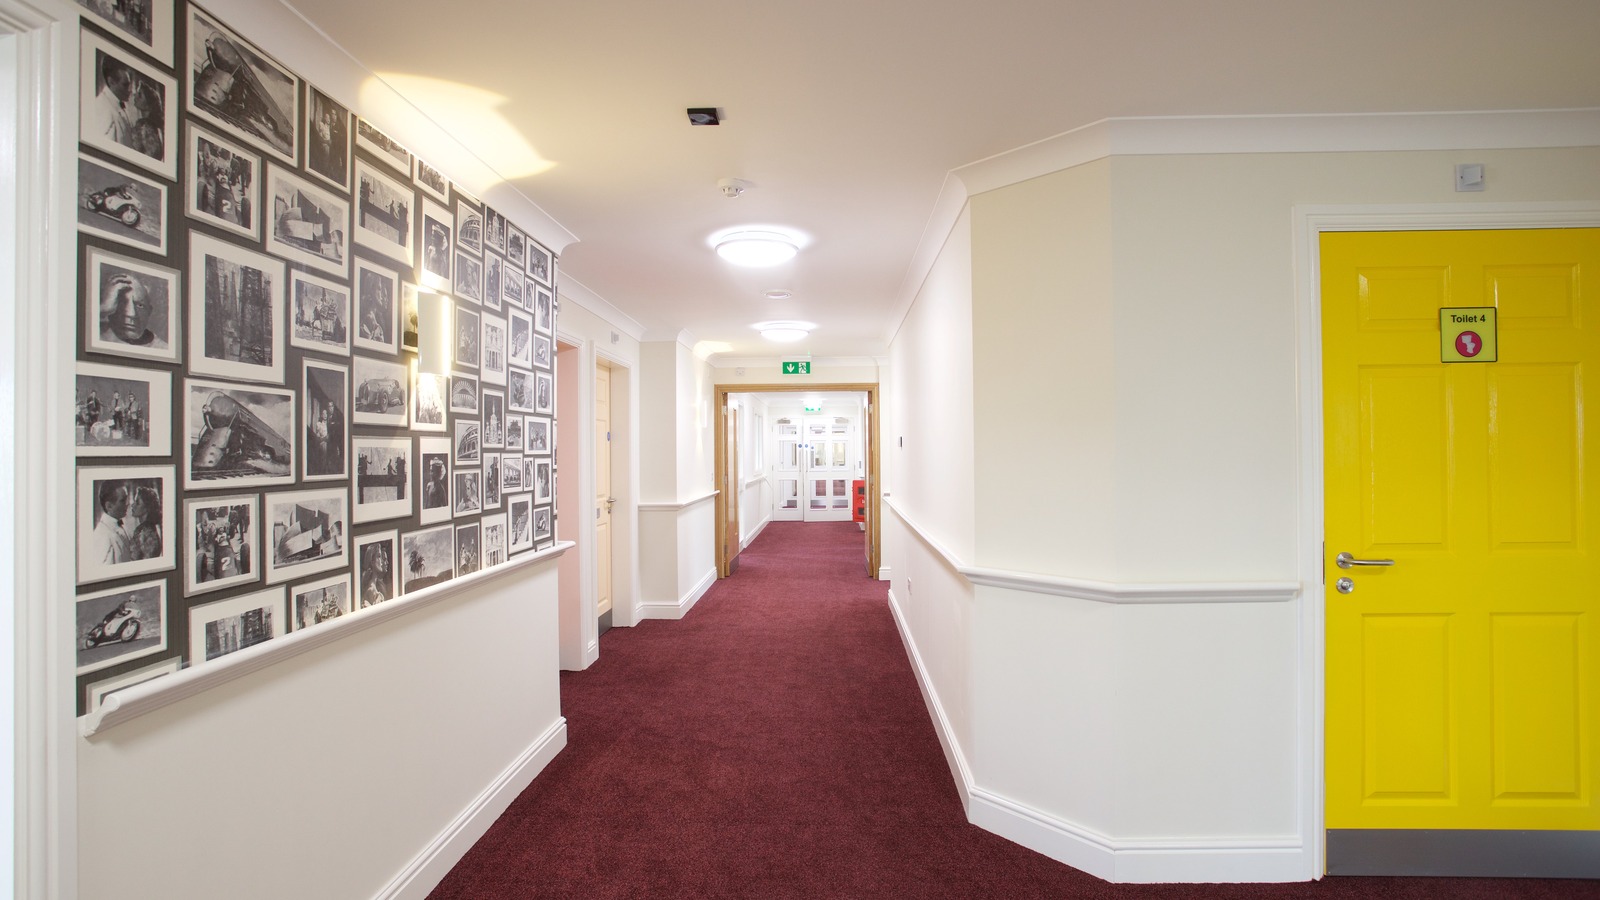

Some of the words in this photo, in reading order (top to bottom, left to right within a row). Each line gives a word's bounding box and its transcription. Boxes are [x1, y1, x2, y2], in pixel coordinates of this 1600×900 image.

[222, 199, 231, 213] 2
[1451, 315, 1477, 323] Toilet
[221, 556, 231, 571] 2
